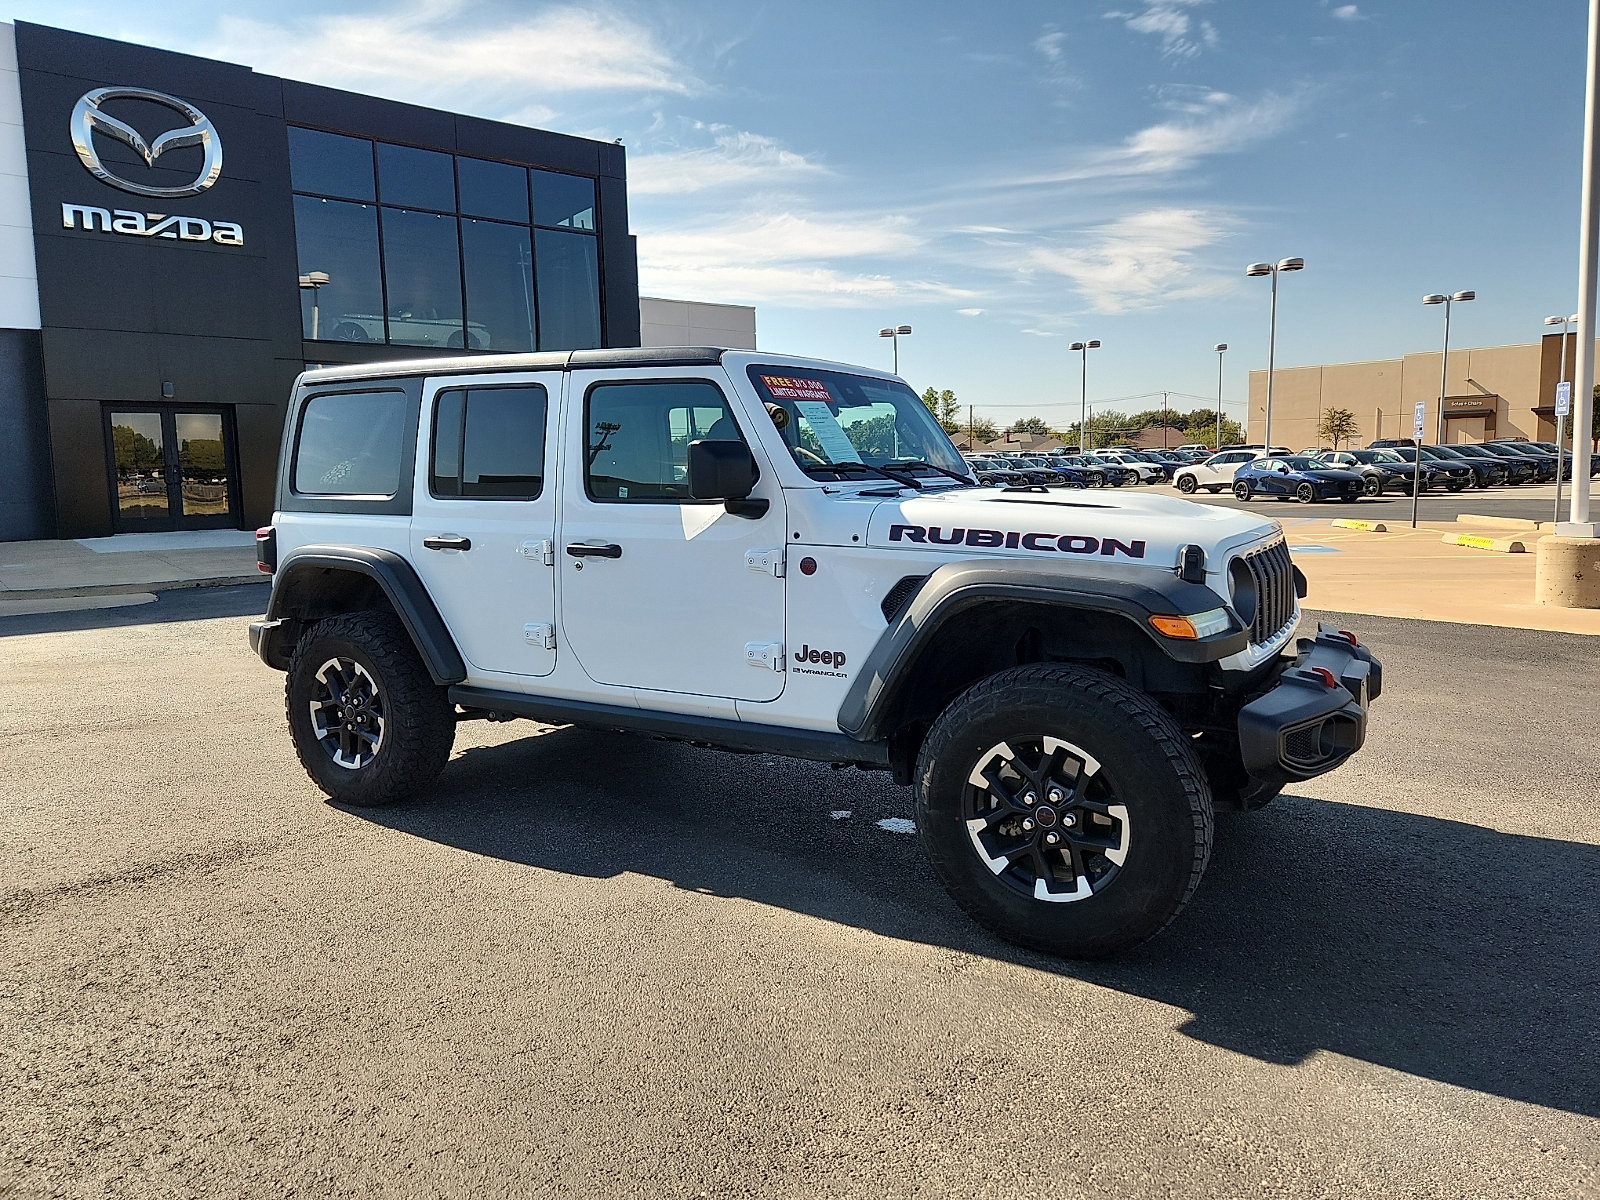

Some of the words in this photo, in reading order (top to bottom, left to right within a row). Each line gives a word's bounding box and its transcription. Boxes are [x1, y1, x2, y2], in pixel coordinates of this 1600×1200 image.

[62, 202, 244, 246] mazda
[764, 376, 792, 386] FREE
[769, 387, 798, 397] LIMITED
[795, 389, 831, 400] WARRANTY
[888, 524, 1146, 558] RUBICON
[795, 644, 846, 669] Jeep
[801, 668, 848, 678] WRANGLER
